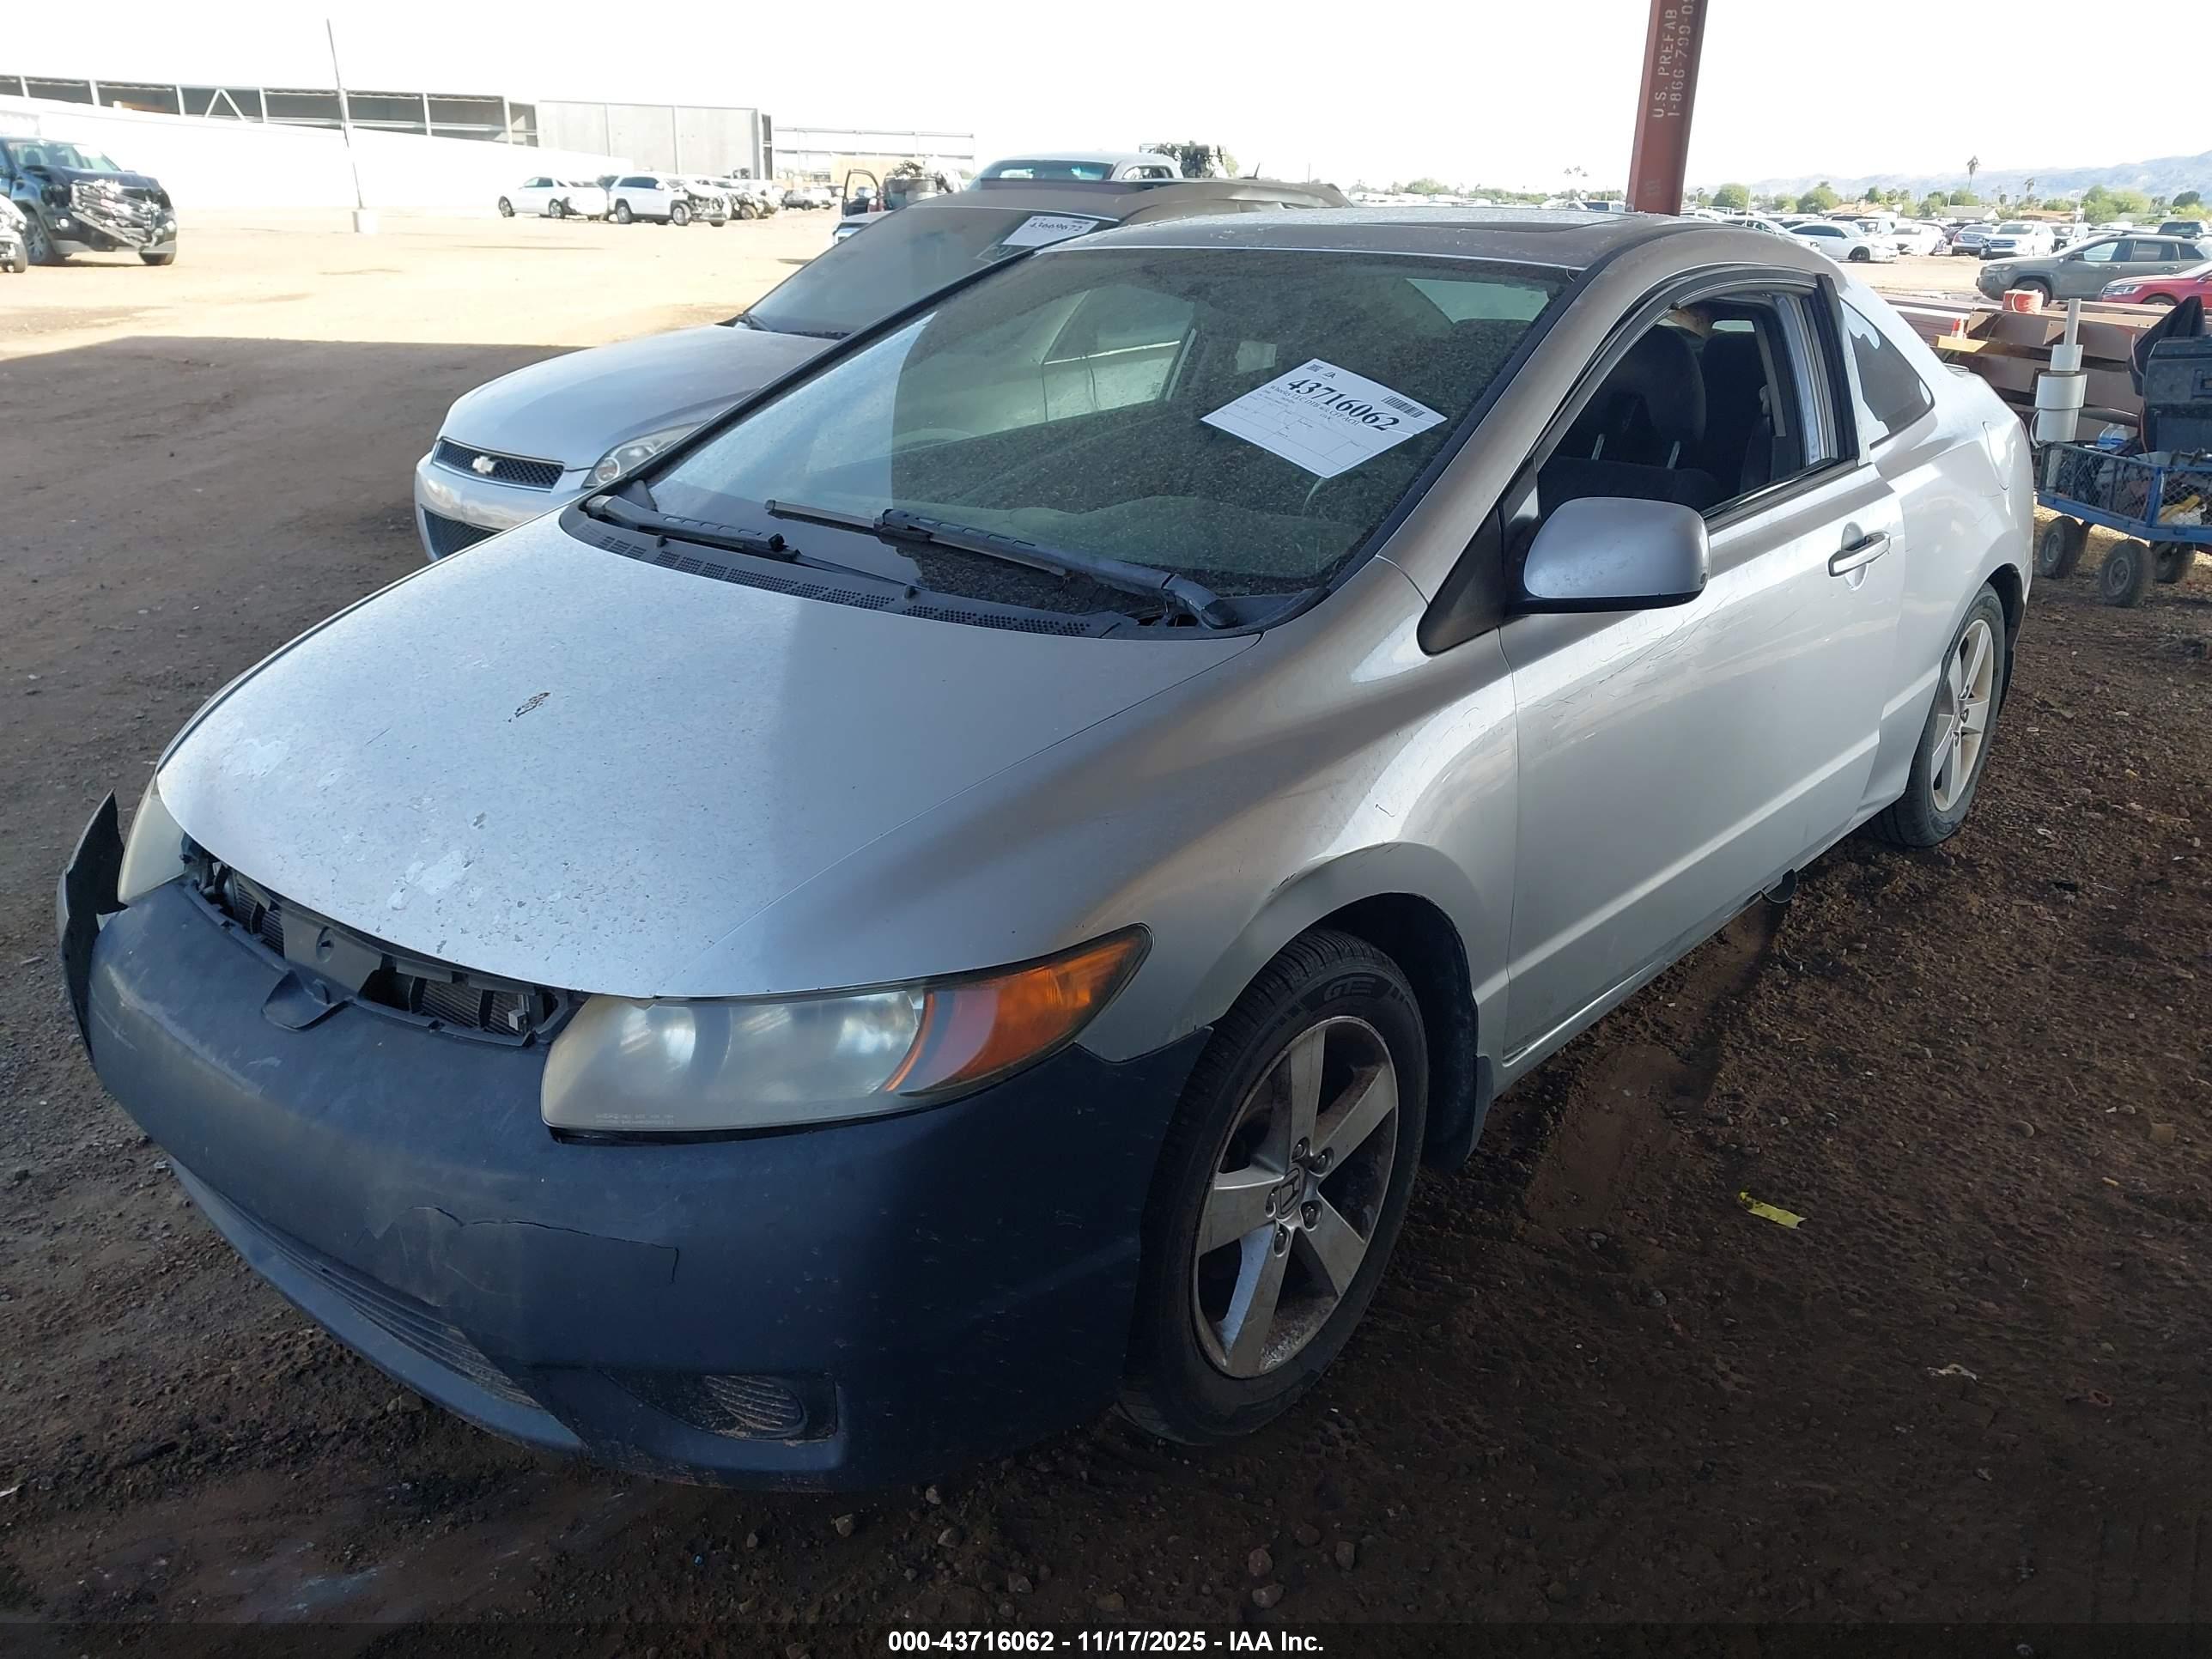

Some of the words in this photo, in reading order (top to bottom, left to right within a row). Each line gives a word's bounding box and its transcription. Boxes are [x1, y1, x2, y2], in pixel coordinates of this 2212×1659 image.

[1657, 9, 1678, 76] PREFAB
[1667, 0, 1696, 117] 1-866-799-0
[1287, 379, 1400, 431] 43716062
